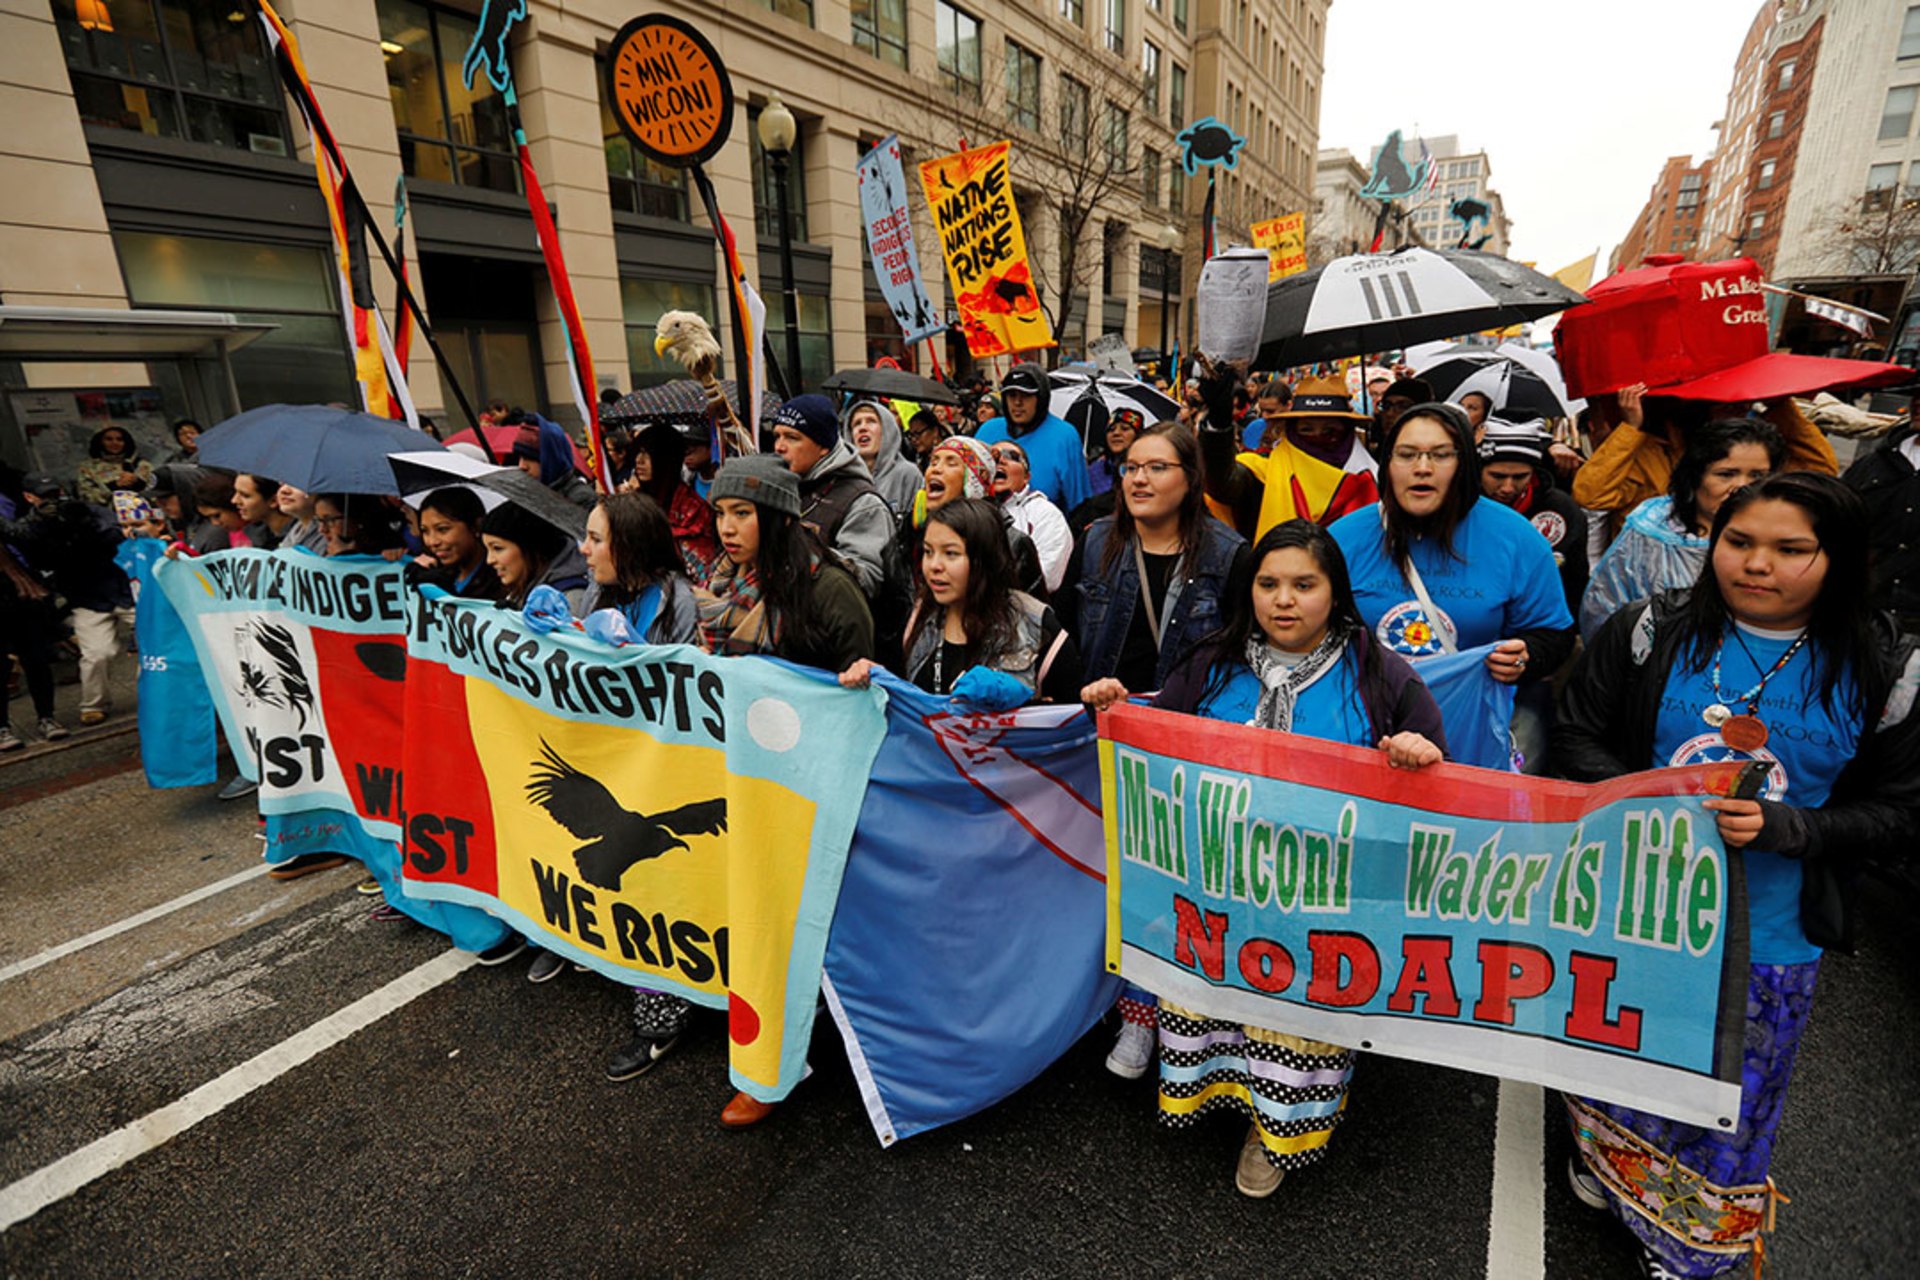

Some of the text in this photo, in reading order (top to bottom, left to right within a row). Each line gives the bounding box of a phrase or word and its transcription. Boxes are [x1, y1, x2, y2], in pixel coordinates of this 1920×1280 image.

[635, 50, 682, 88] MNI
[625, 79, 713, 126] WICONI
[938, 158, 1006, 231] NATIVE
[945, 194, 1010, 257] NATIONS
[951, 220, 1013, 288] RISE
[1701, 275, 1761, 301] Make
[1722, 305, 1769, 325] Grea
[543, 648, 726, 743] RIGHTS
[1119, 749, 1723, 958] Mni Wiconi Water is life
[530, 857, 607, 950] WE
